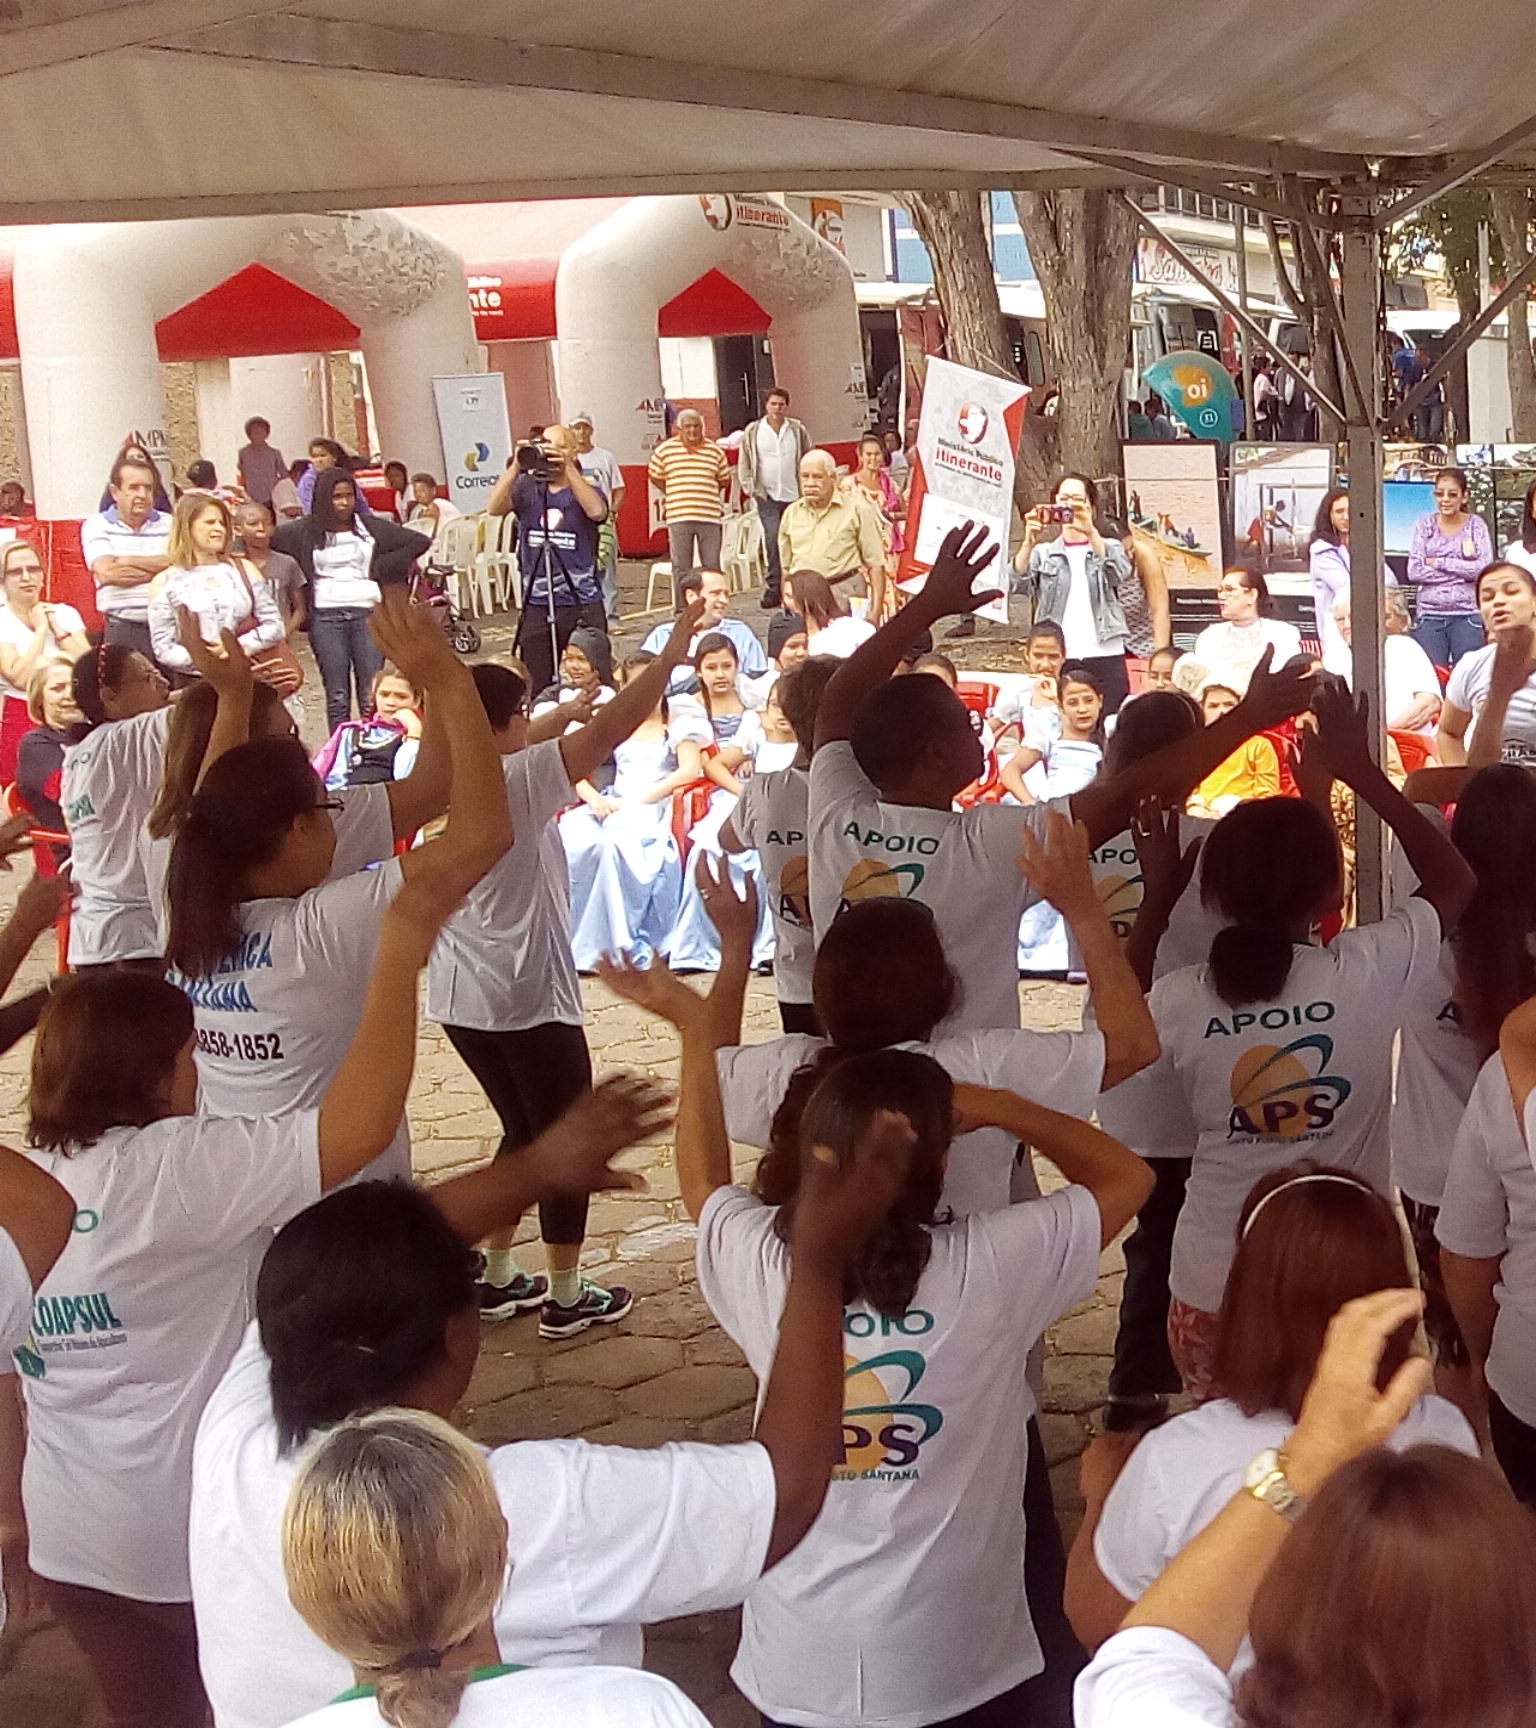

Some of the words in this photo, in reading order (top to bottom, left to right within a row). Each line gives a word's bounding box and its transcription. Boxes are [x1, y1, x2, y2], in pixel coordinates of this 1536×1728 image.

[1187, 378, 1207, 399] oi
[936, 447, 1003, 481] itinerante
[456, 474, 499, 489] Correio
[843, 821, 940, 855] APOIO
[1204, 1001, 1335, 1038] APOIO
[197, 1029, 284, 1061] 858-1852
[1226, 1093, 1335, 1140] APS
[843, 1309, 935, 1337] OIO
[834, 1423, 919, 1467] PS
